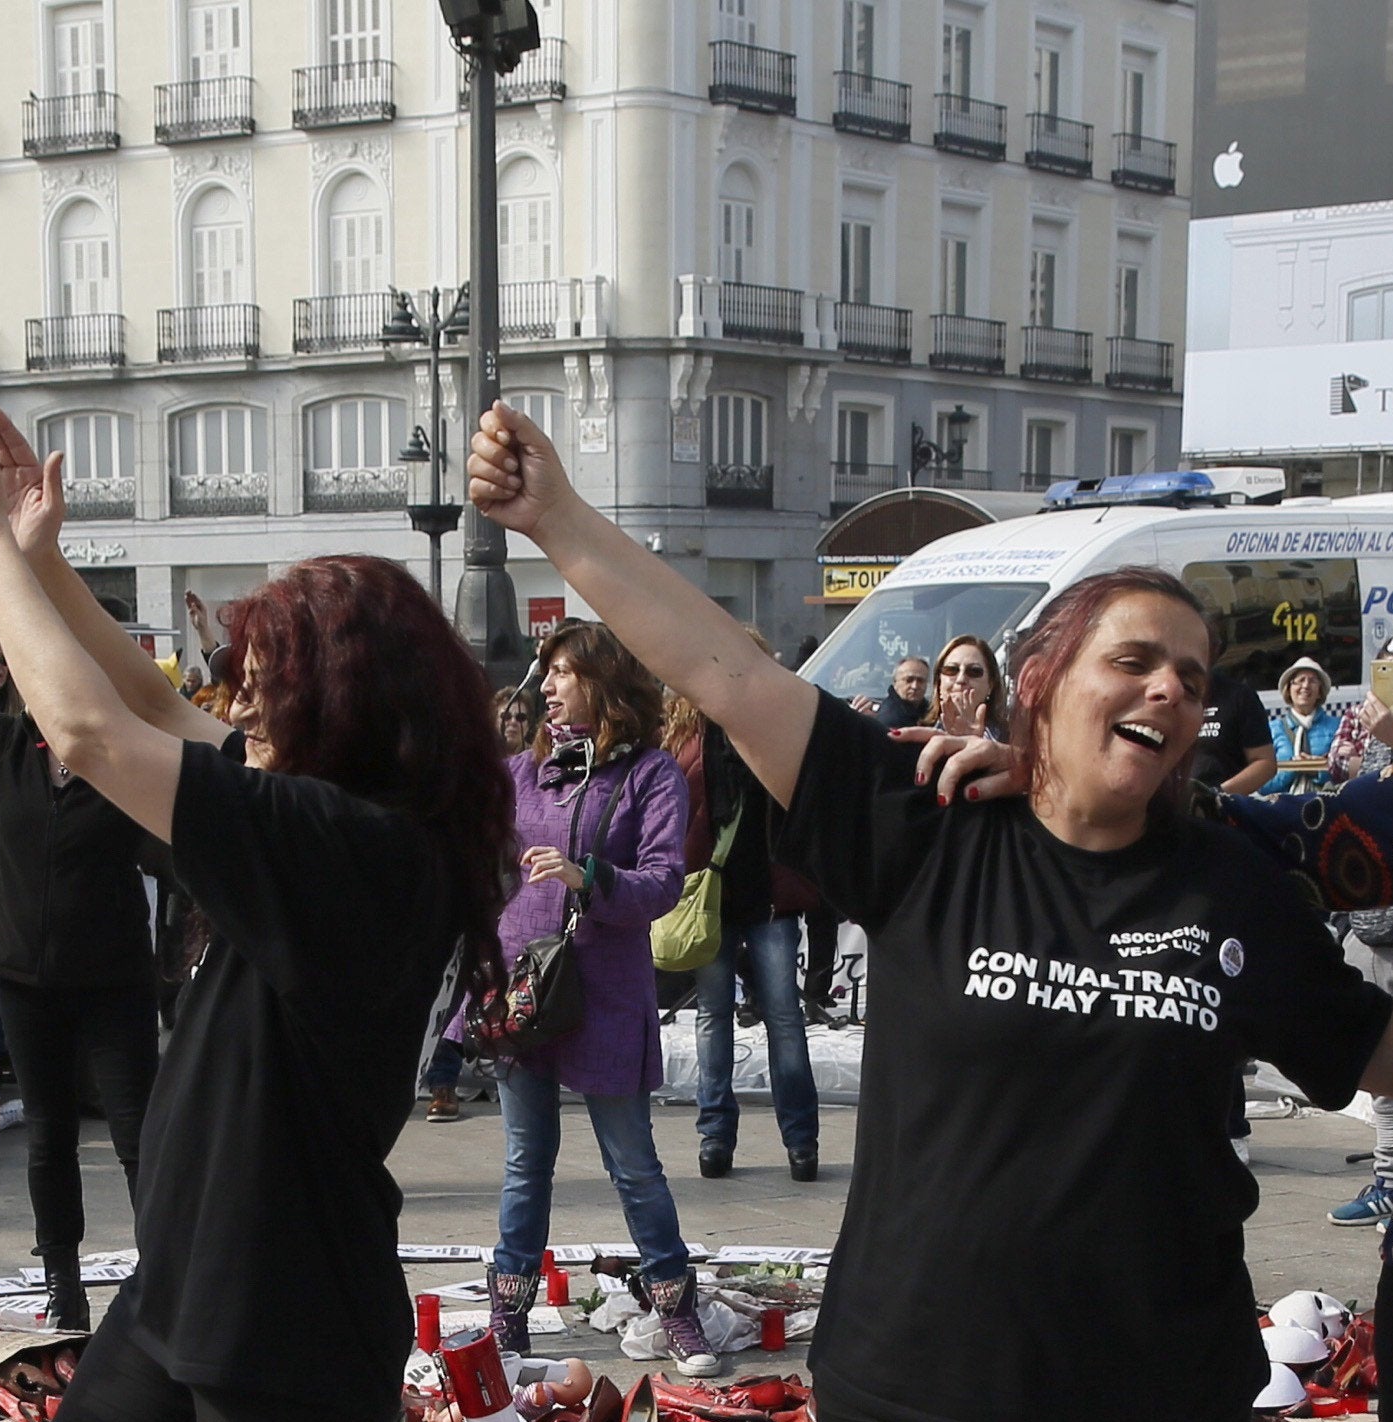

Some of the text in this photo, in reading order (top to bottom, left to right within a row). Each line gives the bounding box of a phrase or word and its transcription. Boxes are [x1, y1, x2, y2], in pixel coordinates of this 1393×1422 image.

[1227, 532, 1279, 553] OFICINA
[1282, 532, 1302, 552] DE
[1304, 527, 1364, 552] ATENCIÓN
[1364, 531, 1382, 551] AL
[1282, 613, 1318, 641] 112
[1109, 925, 1210, 946] ASOCIACIÓN
[1117, 940, 1202, 958] VE-LA LUZ
[967, 947, 1221, 1007] CON MALTRATO
[964, 974, 1218, 1032] NO HAY TRATO
